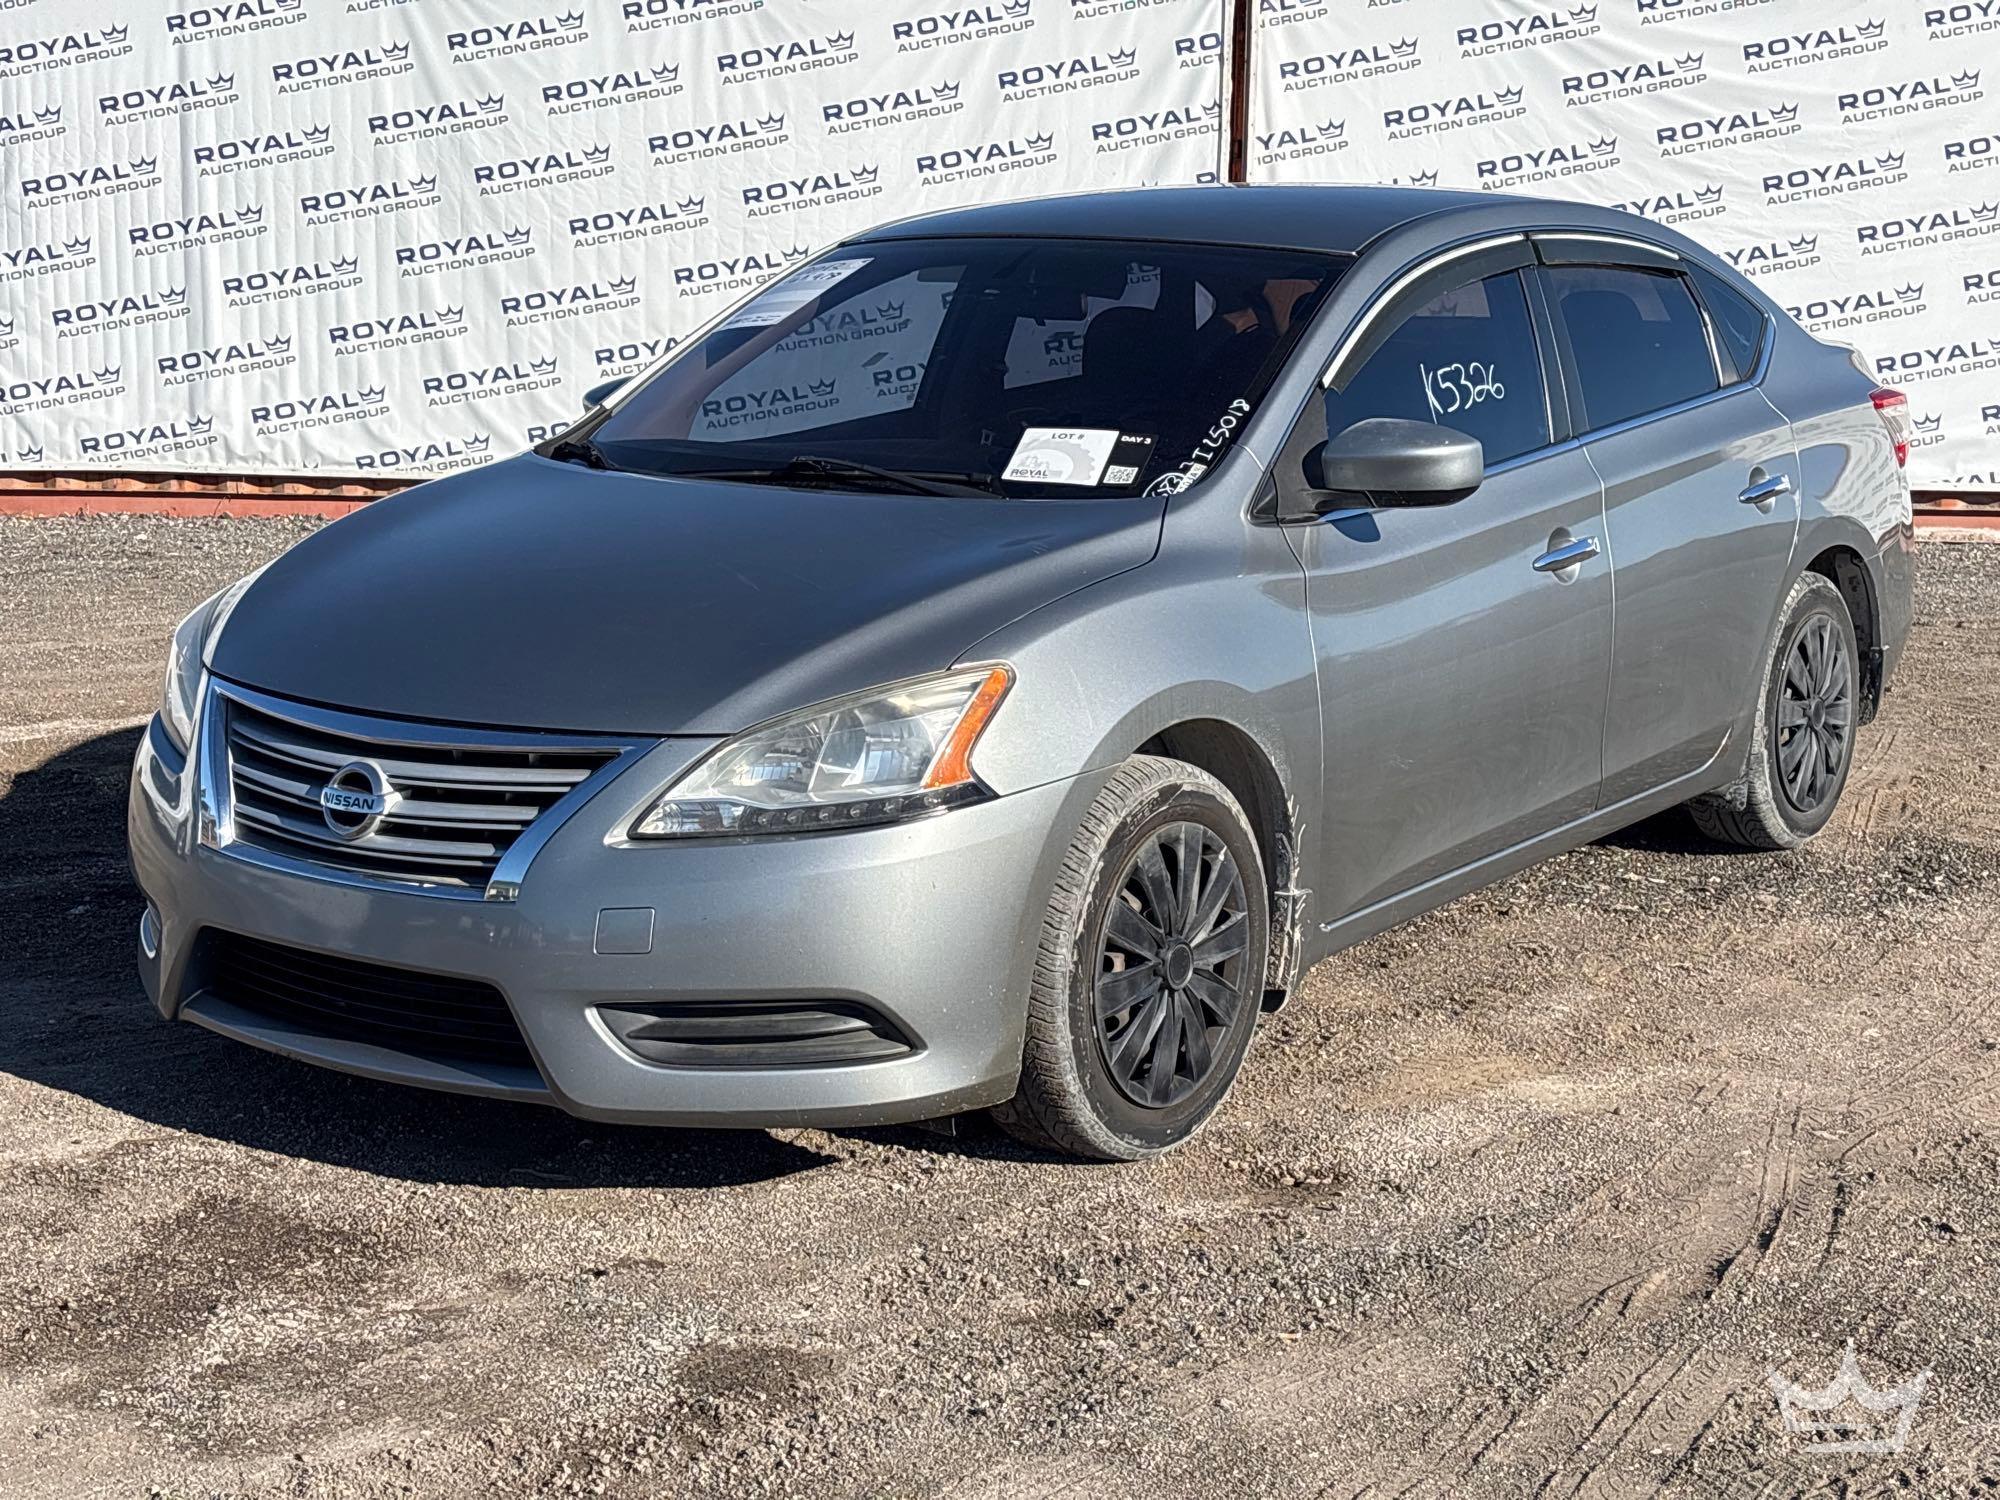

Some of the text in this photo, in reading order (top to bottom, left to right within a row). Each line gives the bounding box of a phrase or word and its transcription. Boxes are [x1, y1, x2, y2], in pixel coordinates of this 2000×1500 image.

[166, 0, 275, 32] ROYAL
[628, 1, 764, 33] AUCTION GROUP
[893, 6, 1003, 40] ROYAL
[1074, 0, 1149, 20] AUCTION
[1269, 8, 1328, 27] GROUP
[1641, 3, 1717, 26] AUCTION
[172, 13, 307, 46] AUCTION GROUP
[447, 18, 557, 50] ROYAL
[898, 20, 1034, 53] AUCTION GROUP
[1457, 12, 1569, 46] ROYAL
[1461, 26, 1600, 59] AUCTION GROUP
[1743, 28, 1856, 61] ROYAL
[0, 45, 133, 79] AUCTION GROUP
[453, 32, 588, 64] AUCTION GROUP
[717, 39, 827, 72] ROYAL
[1280, 46, 1390, 79] ROYAL
[1748, 40, 1888, 74] AUCTION GROUP
[272, 49, 382, 82] ROYAL
[278, 63, 414, 95] AUCTION GROUP
[722, 53, 858, 86] AUCTION GROUP
[998, 56, 1108, 89] ROYAL
[1284, 59, 1421, 92] AUCTION GROUP
[1562, 61, 1675, 94] ROYAL
[99, 81, 208, 114] ROYAL
[542, 71, 652, 103] ROYAL
[548, 84, 683, 116] AUCTION GROUP
[1003, 69, 1140, 102] AUCTION GROUP
[1566, 74, 1707, 108] AUCTION GROUP
[1838, 78, 1951, 112] ROYAL
[105, 94, 239, 127] AUCTION GROUP
[368, 102, 477, 134] ROYAL
[822, 89, 932, 122] ROYAL
[828, 102, 964, 135] AUCTION GROUP
[1384, 94, 1494, 128] ROYAL
[1842, 91, 1983, 124] AUCTION GROUP
[8, 126, 66, 145] GROUP
[374, 115, 508, 147] AUCTION GROUP
[648, 121, 757, 153] ROYAL
[1092, 107, 1202, 141] ROYAL
[1096, 123, 1221, 154] AUCTION GROU
[1388, 107, 1526, 141] AUCTION GROUP
[1656, 112, 1769, 145] ROYAL
[194, 132, 303, 164] ROYAL
[654, 134, 788, 166] AUCTION GROUP
[916, 140, 1026, 174] ROYAL
[1290, 140, 1348, 159] GROUP
[1661, 124, 1801, 158] AUCTION GROUP
[199, 146, 335, 178] AUCTION GROUP
[474, 152, 583, 184] ROYAL
[922, 154, 1057, 186] AUCTION GROUP
[1477, 145, 1588, 178] ROYAL
[1482, 158, 1620, 190] AUCTION GROUP
[1763, 160, 1876, 193] ROYAL
[21, 164, 130, 197] ROYAL
[28, 177, 162, 210] AUCTION GROUP
[480, 166, 614, 196] AUCTION GROUP
[742, 173, 851, 205] ROYAL
[1767, 173, 1908, 206] AUCTION GROUP
[300, 182, 409, 214] ROYAL
[306, 196, 441, 227] AUCTION GROUP
[748, 186, 882, 218] AUCTION GROUP
[128, 212, 236, 245] ROYAL
[569, 204, 678, 235] ROYAL
[1666, 206, 1726, 224] GROUP
[1857, 210, 1970, 243] ROYAL
[134, 226, 267, 258] AUCTION GROUP
[574, 217, 708, 248] AUCTION GROUP
[1861, 234, 1938, 256] AUCTION
[396, 234, 504, 265] ROYAL
[402, 247, 535, 278] AUCTION GROUP
[1760, 256, 1820, 274] GROUP
[38, 257, 97, 276] GROUP
[223, 264, 332, 295] ROYAL
[674, 253, 782, 285] ROYAL
[229, 277, 363, 308] AUCTION GROUP
[501, 283, 609, 314] ROYAL
[679, 277, 752, 298] AUCTION
[52, 293, 160, 326] ROYAL
[58, 307, 190, 339] AUCTION GROUP
[506, 297, 640, 327] AUCTION GROUP
[1866, 304, 1926, 322] GROUP
[328, 313, 437, 344] ROYAL
[335, 326, 468, 356] AUCTION GROUP
[775, 332, 848, 352] AUCTION
[158, 342, 265, 374] ROYAL
[164, 356, 296, 387] AUCTION GROUP
[1876, 342, 1988, 374] ROYAL
[423, 364, 530, 394] ROYAL
[1881, 366, 1956, 385] AUCTION
[68, 386, 125, 404] GROUP
[429, 377, 561, 407] AUCTION GROUP
[703, 386, 808, 417] ROYAL
[1420, 362, 1504, 424] K5326
[251, 393, 359, 424] ROYAL
[256, 406, 390, 436] AUCTION GROUP
[706, 397, 840, 430] AUCTION GROUP
[80, 423, 187, 454] ROYAL
[162, 436, 218, 453] GROUP
[1121, 435, 1141, 443] DAY
[356, 441, 462, 469] ROYAL
[437, 454, 494, 471] GROUP
[323, 791, 375, 810] NISSAN
